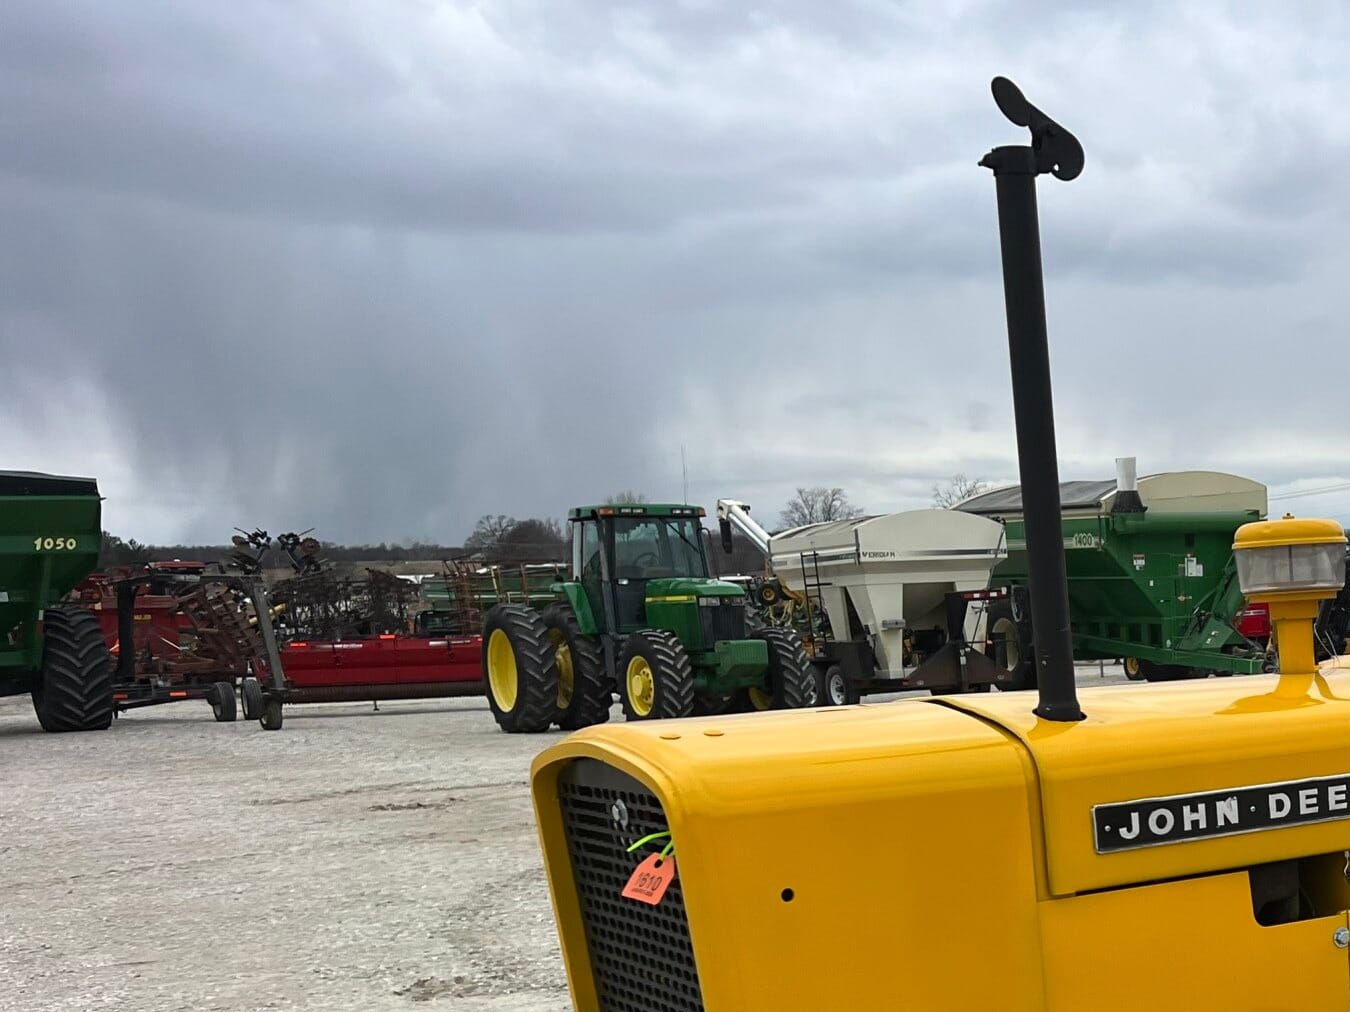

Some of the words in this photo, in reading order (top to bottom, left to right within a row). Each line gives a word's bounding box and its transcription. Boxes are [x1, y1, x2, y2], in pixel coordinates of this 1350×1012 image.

[33, 537, 77, 551] 1050
[1073, 533, 1094, 548] 1400
[1118, 796, 1240, 840] JOHN
